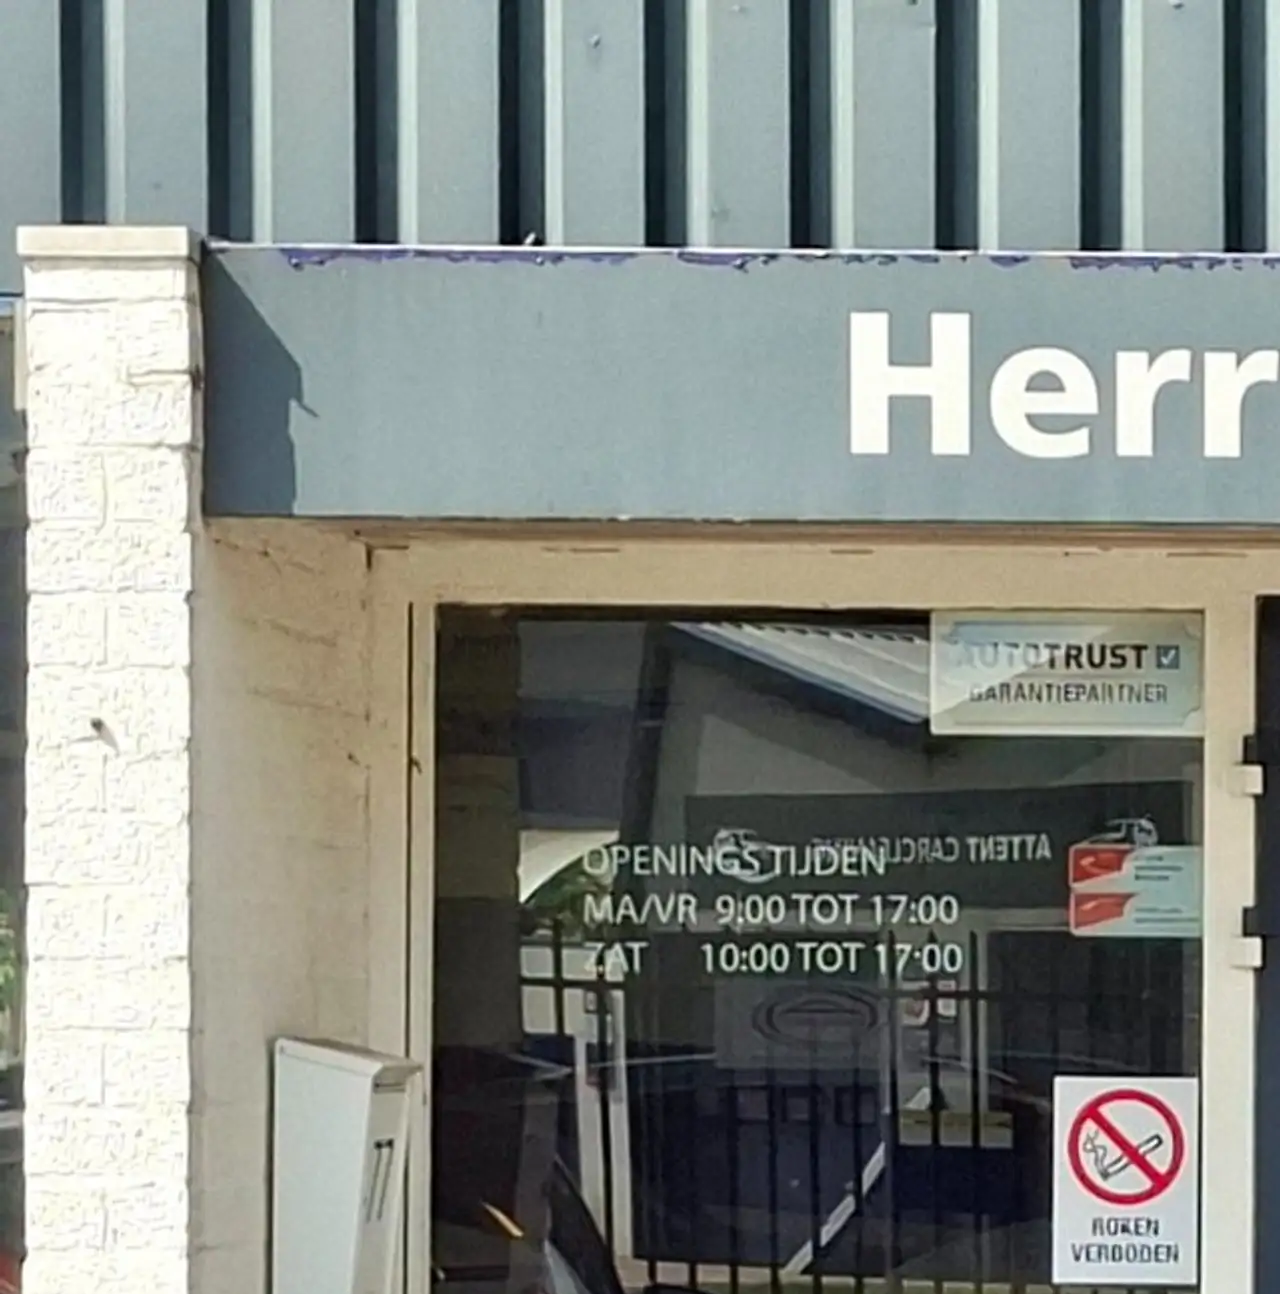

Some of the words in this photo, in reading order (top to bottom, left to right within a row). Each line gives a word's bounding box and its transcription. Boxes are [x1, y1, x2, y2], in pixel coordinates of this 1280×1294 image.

[956, 643, 1149, 670] AUTOTRUST
[969, 682, 1168, 703] GARANTIEPARTNER
[582, 844, 763, 877] OPENINGS
[771, 845, 887, 878] TIJDEN
[582, 893, 698, 926] MA/VR
[714, 892, 787, 926] 9:00
[790, 894, 861, 926] TOT
[869, 894, 959, 926] 17:00
[582, 941, 649, 974] ZAT
[700, 942, 791, 974] 10:00
[795, 942, 866, 974] TOT
[875, 942, 964, 974] 17:00
[1091, 1217, 1160, 1237] ROKEN
[1070, 1243, 1180, 1264] VERBODEN
